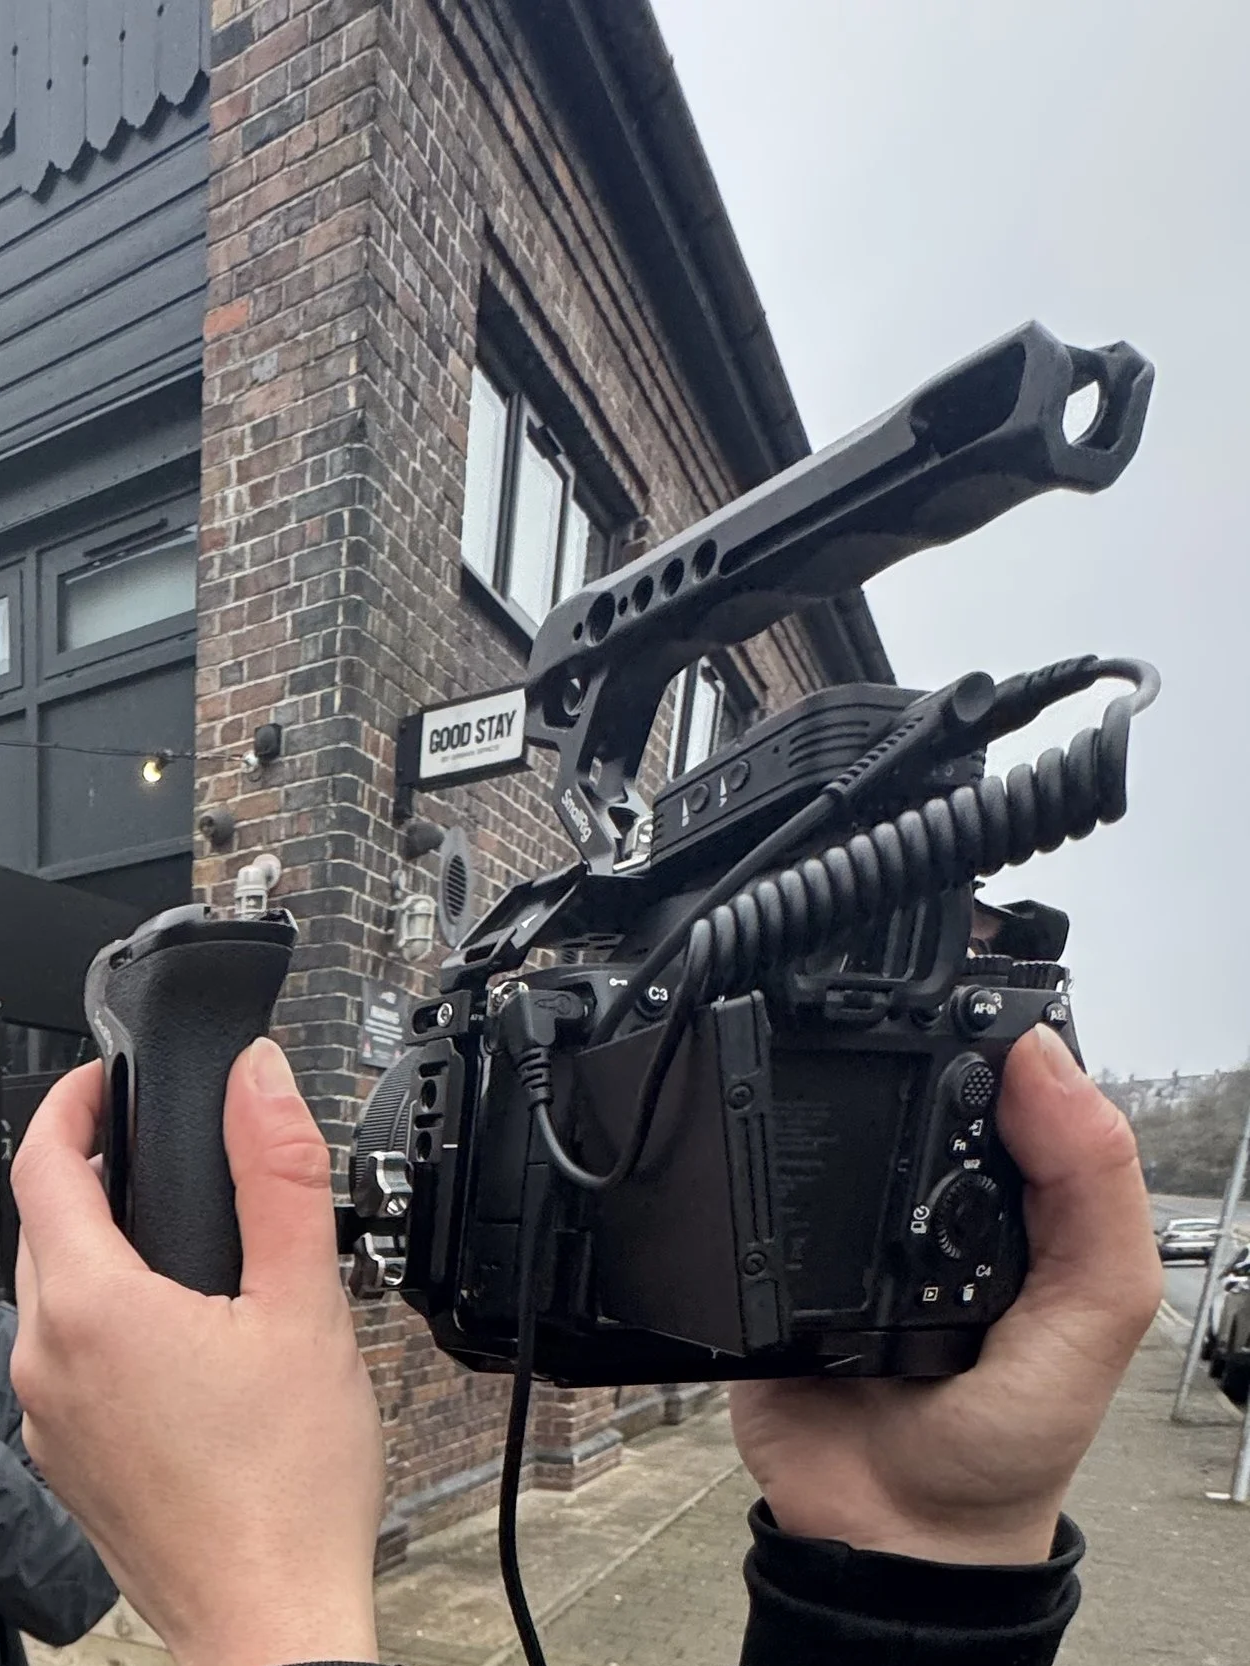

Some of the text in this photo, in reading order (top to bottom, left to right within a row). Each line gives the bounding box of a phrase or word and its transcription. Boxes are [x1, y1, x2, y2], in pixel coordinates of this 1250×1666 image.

[429, 722, 471, 754] GOOD
[474, 709, 517, 744] STAY
[561, 788, 592, 843] SmallRig
[648, 986, 669, 1001] C3
[953, 1139, 966, 1151] Fn
[976, 1264, 992, 1277] C4
